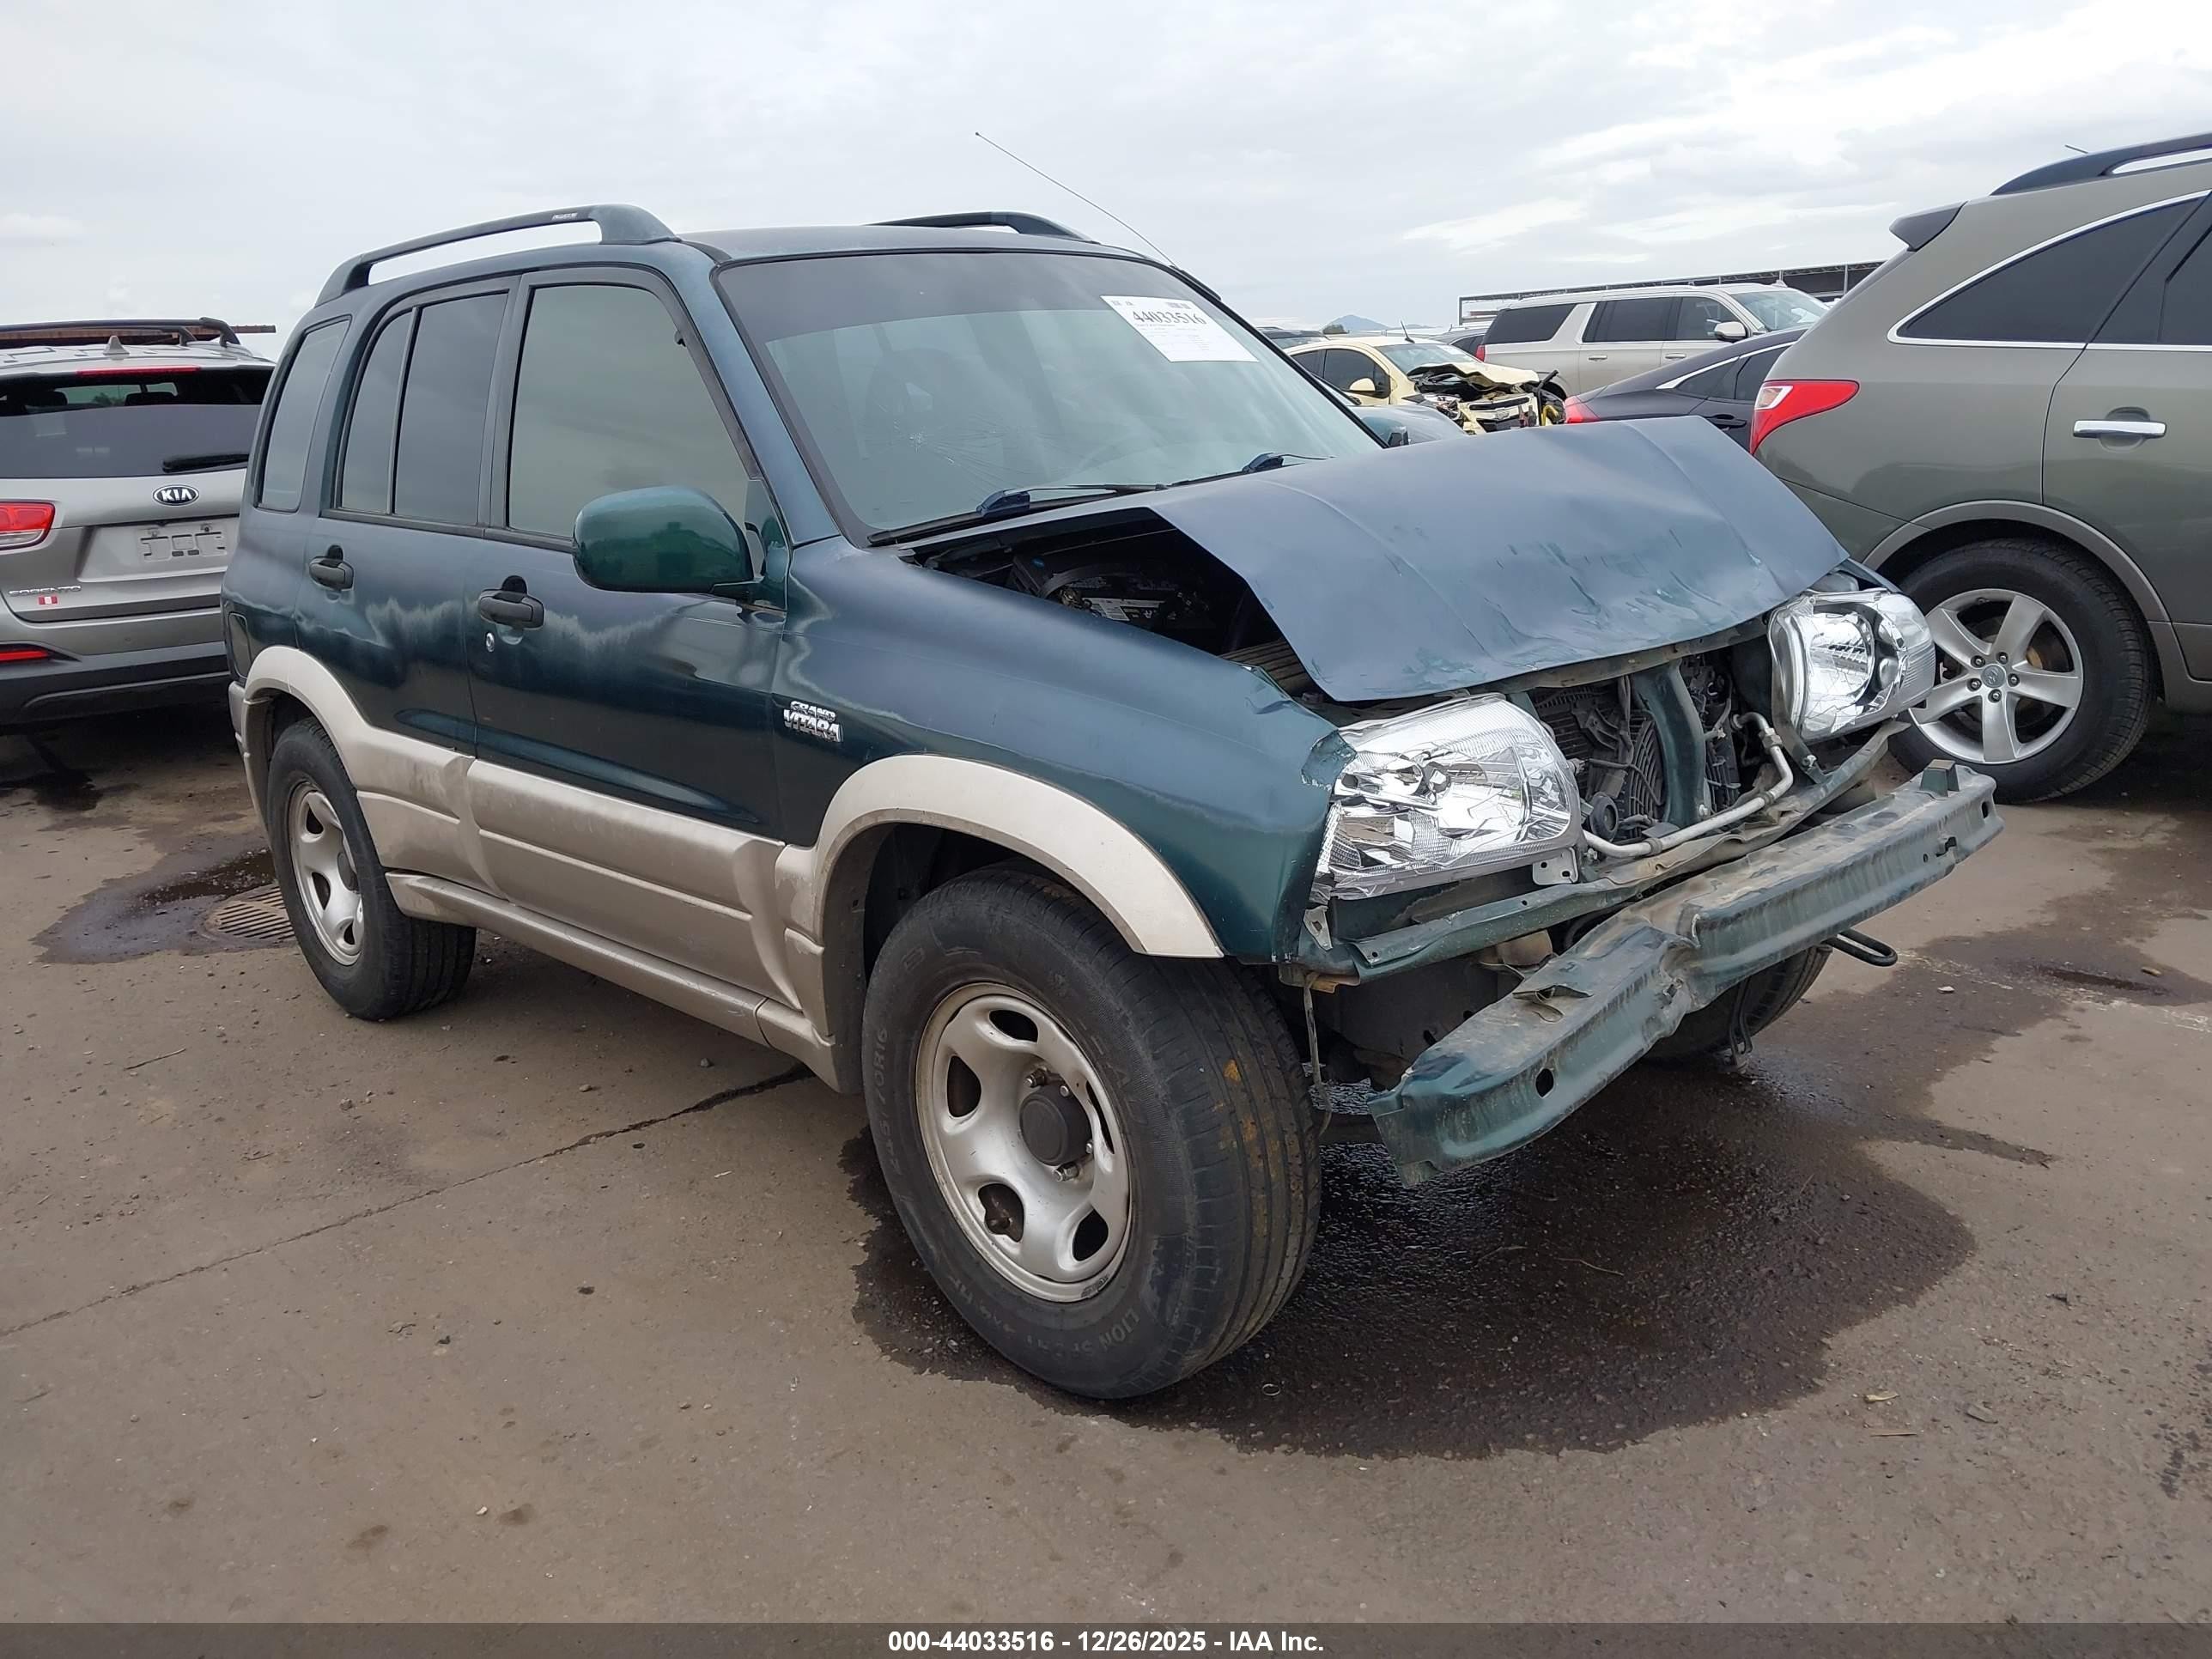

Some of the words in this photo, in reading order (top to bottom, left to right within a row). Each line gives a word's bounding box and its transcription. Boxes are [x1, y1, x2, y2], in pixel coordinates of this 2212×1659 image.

[1132, 311, 1206, 325] 44033516
[161, 488, 193, 501] KIA
[783, 708, 843, 743] VITARA
